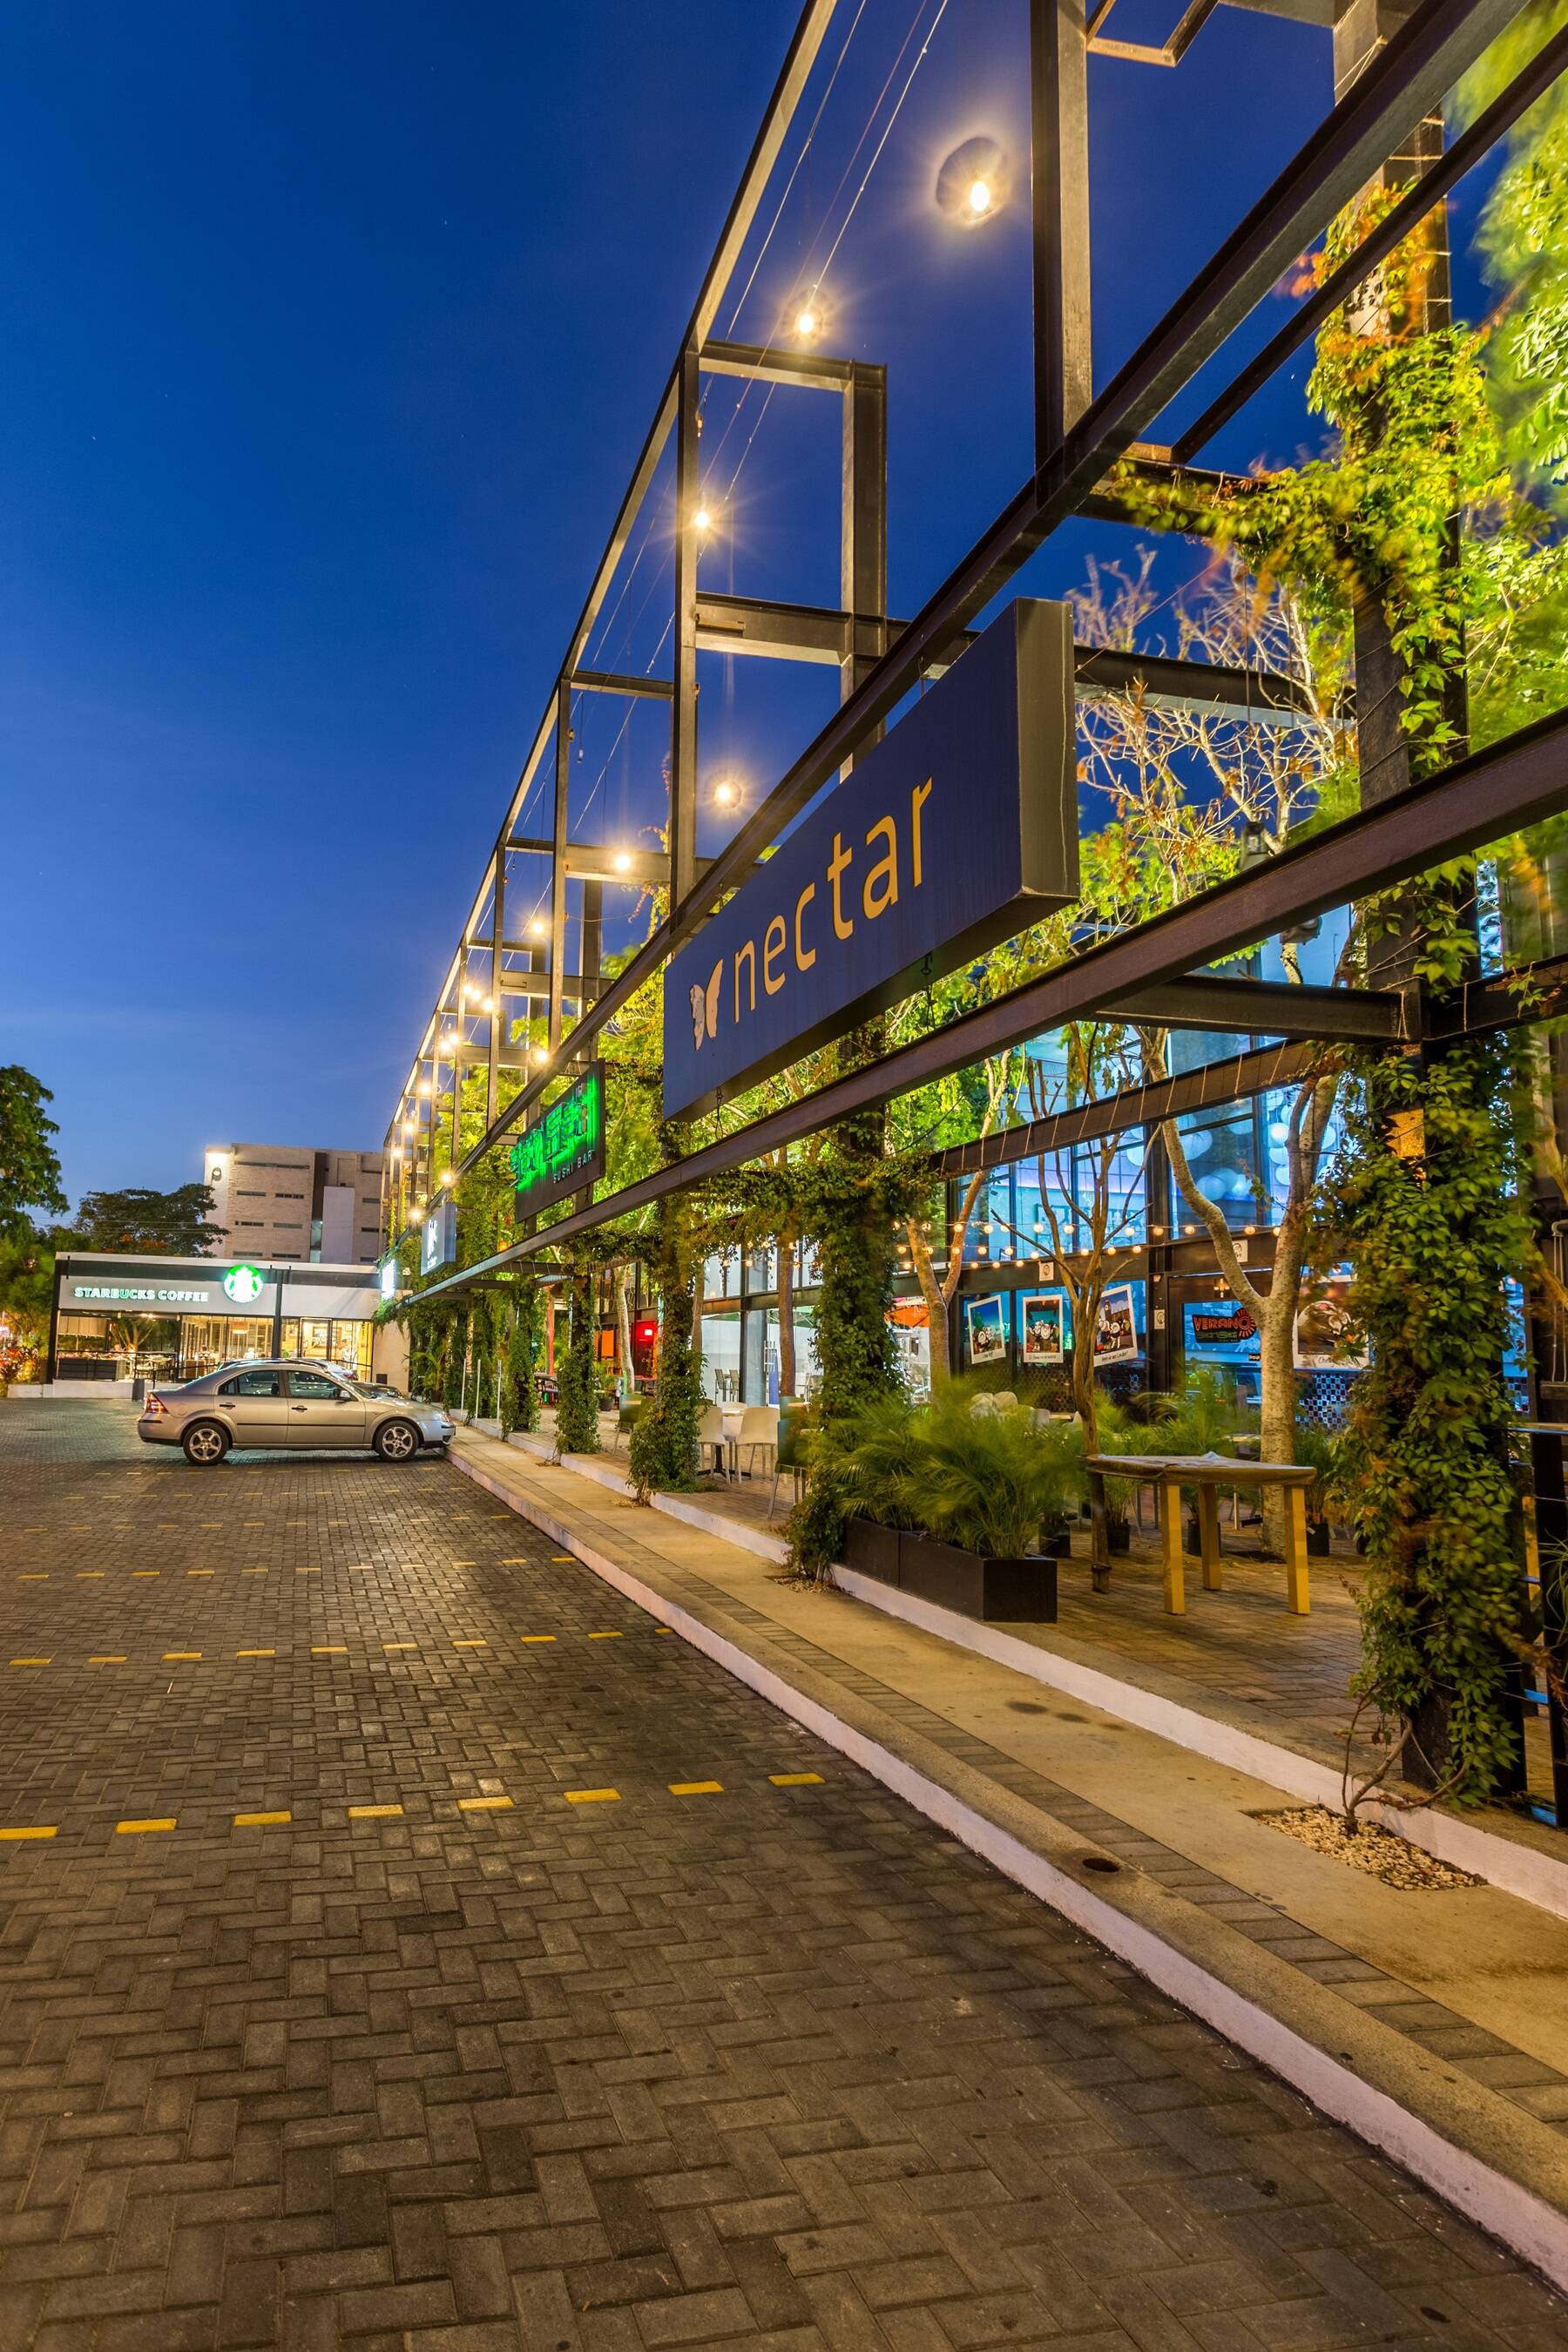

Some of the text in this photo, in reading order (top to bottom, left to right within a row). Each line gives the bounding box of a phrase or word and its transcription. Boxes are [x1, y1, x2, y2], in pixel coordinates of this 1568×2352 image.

[734, 777, 932, 1024] nectar
[553, 1150, 592, 1184] SUSHI BAR
[74, 1287, 209, 1302] STARBUCKS COFFEE
[1193, 1315, 1251, 1332] VERANO
